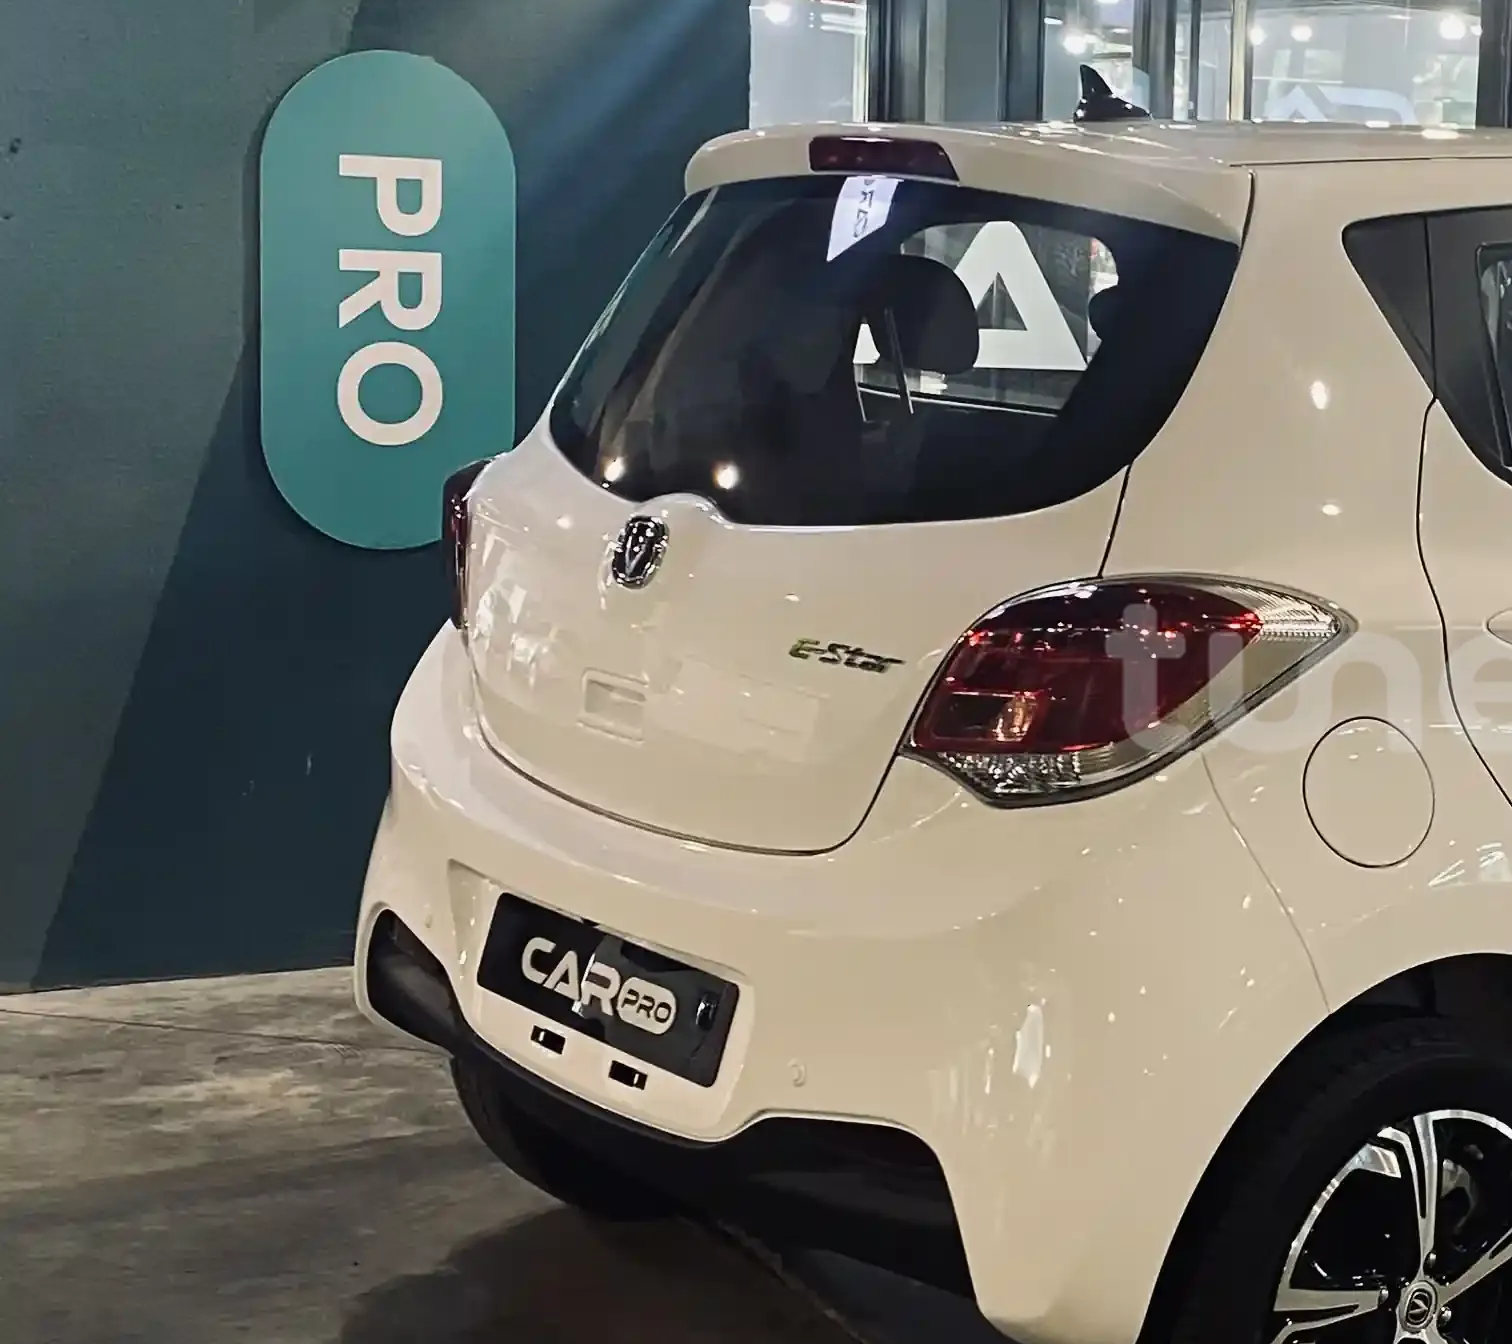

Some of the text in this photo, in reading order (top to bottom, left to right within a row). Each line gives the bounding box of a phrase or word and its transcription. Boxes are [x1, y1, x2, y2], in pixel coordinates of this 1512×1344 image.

[337, 154, 444, 446] PRO
[521, 936, 672, 1023] CAR PRO
